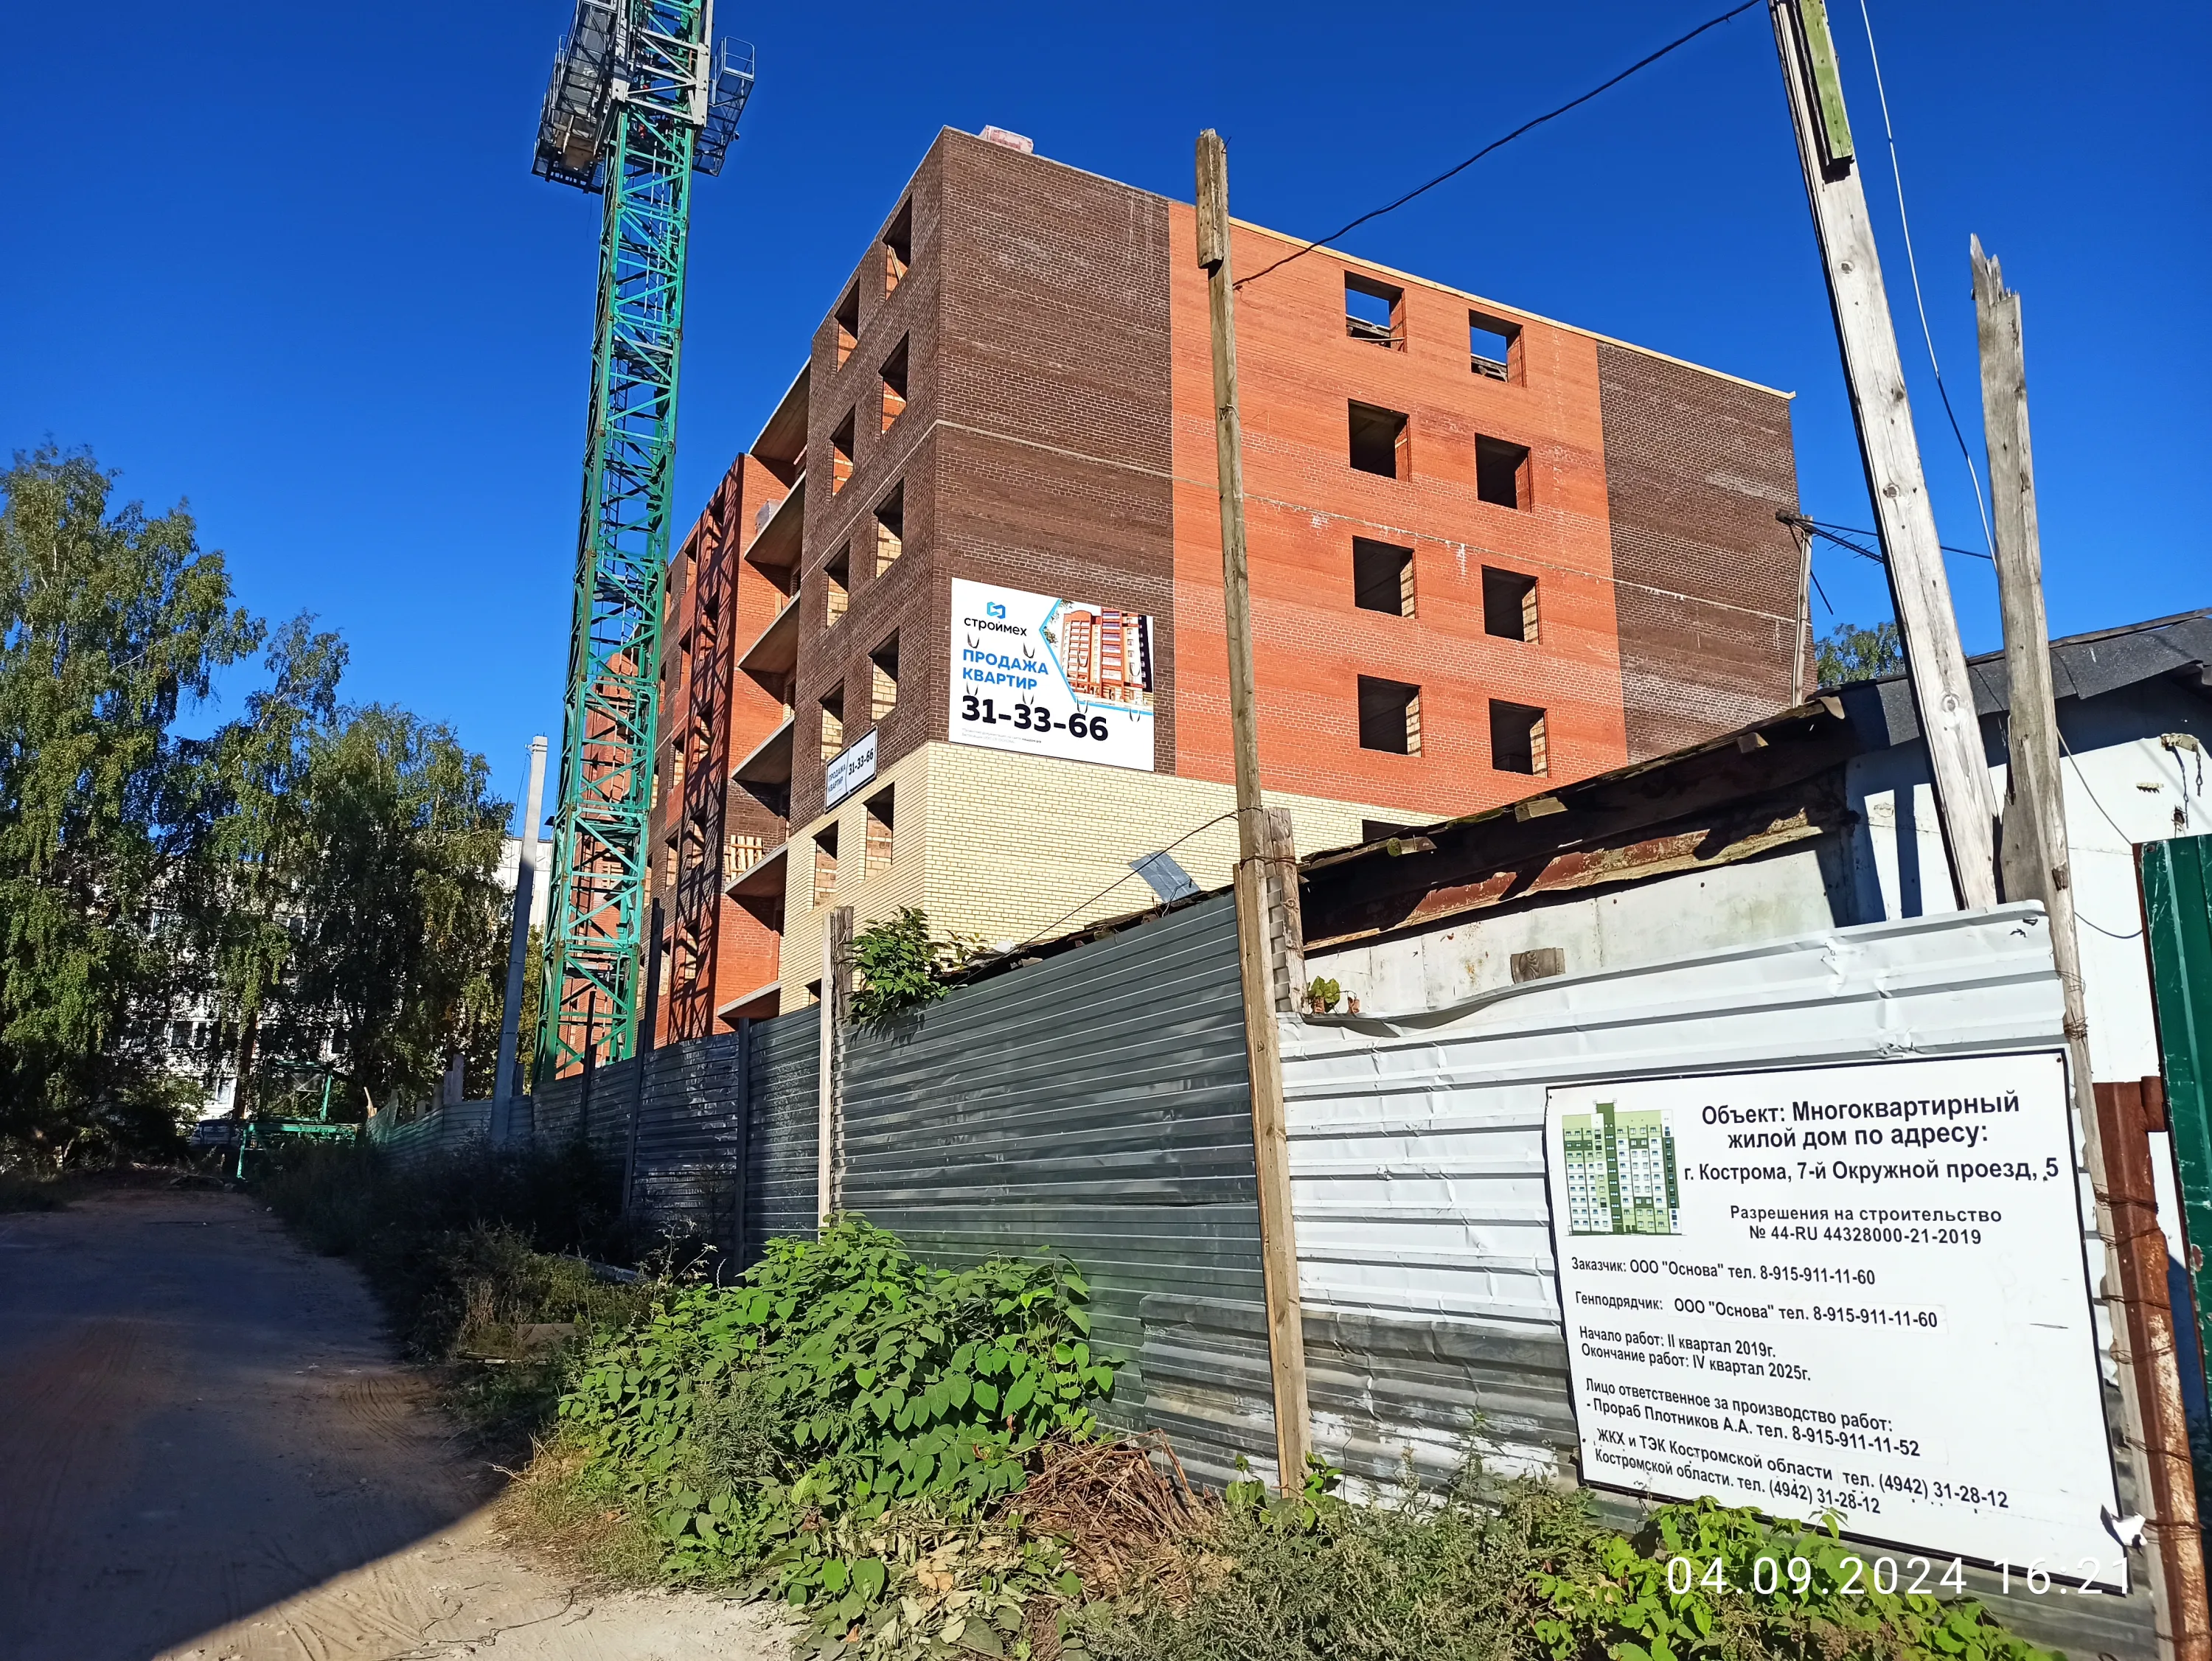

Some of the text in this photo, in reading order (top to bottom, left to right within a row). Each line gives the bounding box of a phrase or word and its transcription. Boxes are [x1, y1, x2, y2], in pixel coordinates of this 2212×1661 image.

[964, 617, 1027, 637] строймех
[963, 649, 1048, 675] ПРОДАЖА
[962, 667, 1037, 690] КВАРТИР
[961, 695, 1108, 741] 31-33-66
[829, 764, 846, 782] ПРОДАЖА
[849, 748, 874, 776] 31-33-66
[828, 776, 844, 793] КВАРТИР
[1703, 1090, 2019, 1124] Объект: Многоквартирный
[1728, 1126, 1987, 1149] жилой дом по адресу:
[1685, 1157, 2059, 1184] г. Кострома, 7-й Окружной проезд, 5
[1731, 1205, 2001, 1224] Разрешения на строительство
[1750, 1226, 1980, 1244] № 44-RU 44328000-21-2019
[1572, 1257, 1874, 1284] Заказчик: ООО "Основа" тел. 8-915-911-11-60
[1576, 1292, 1937, 1327] Генподрядчик: ООО "Основа" тел. 8-915-911-11-60
[1580, 1326, 1775, 1357] Начало работ: II квартал 2019г.
[1582, 1343, 1810, 1380] Окончание работ: IV квартал 2025г.
[1587, 1378, 1892, 1431] Лицо ответственное за производство работ:
[1593, 1398, 1641, 1418] Прораб
[1645, 1406, 1718, 1429] Плотников
[1724, 1417, 1753, 1434] А.А.
[1756, 1424, 1787, 1438] тел.
[1792, 1426, 1920, 1456] 8-915-911-11-52
[1596, 1449, 1880, 1514] Костромской области. тел. (4942) 31-28-12
[1597, 1428, 2008, 1508] ЖКХ и ТЭК Костромской области тел. (4942) 31-28-12
